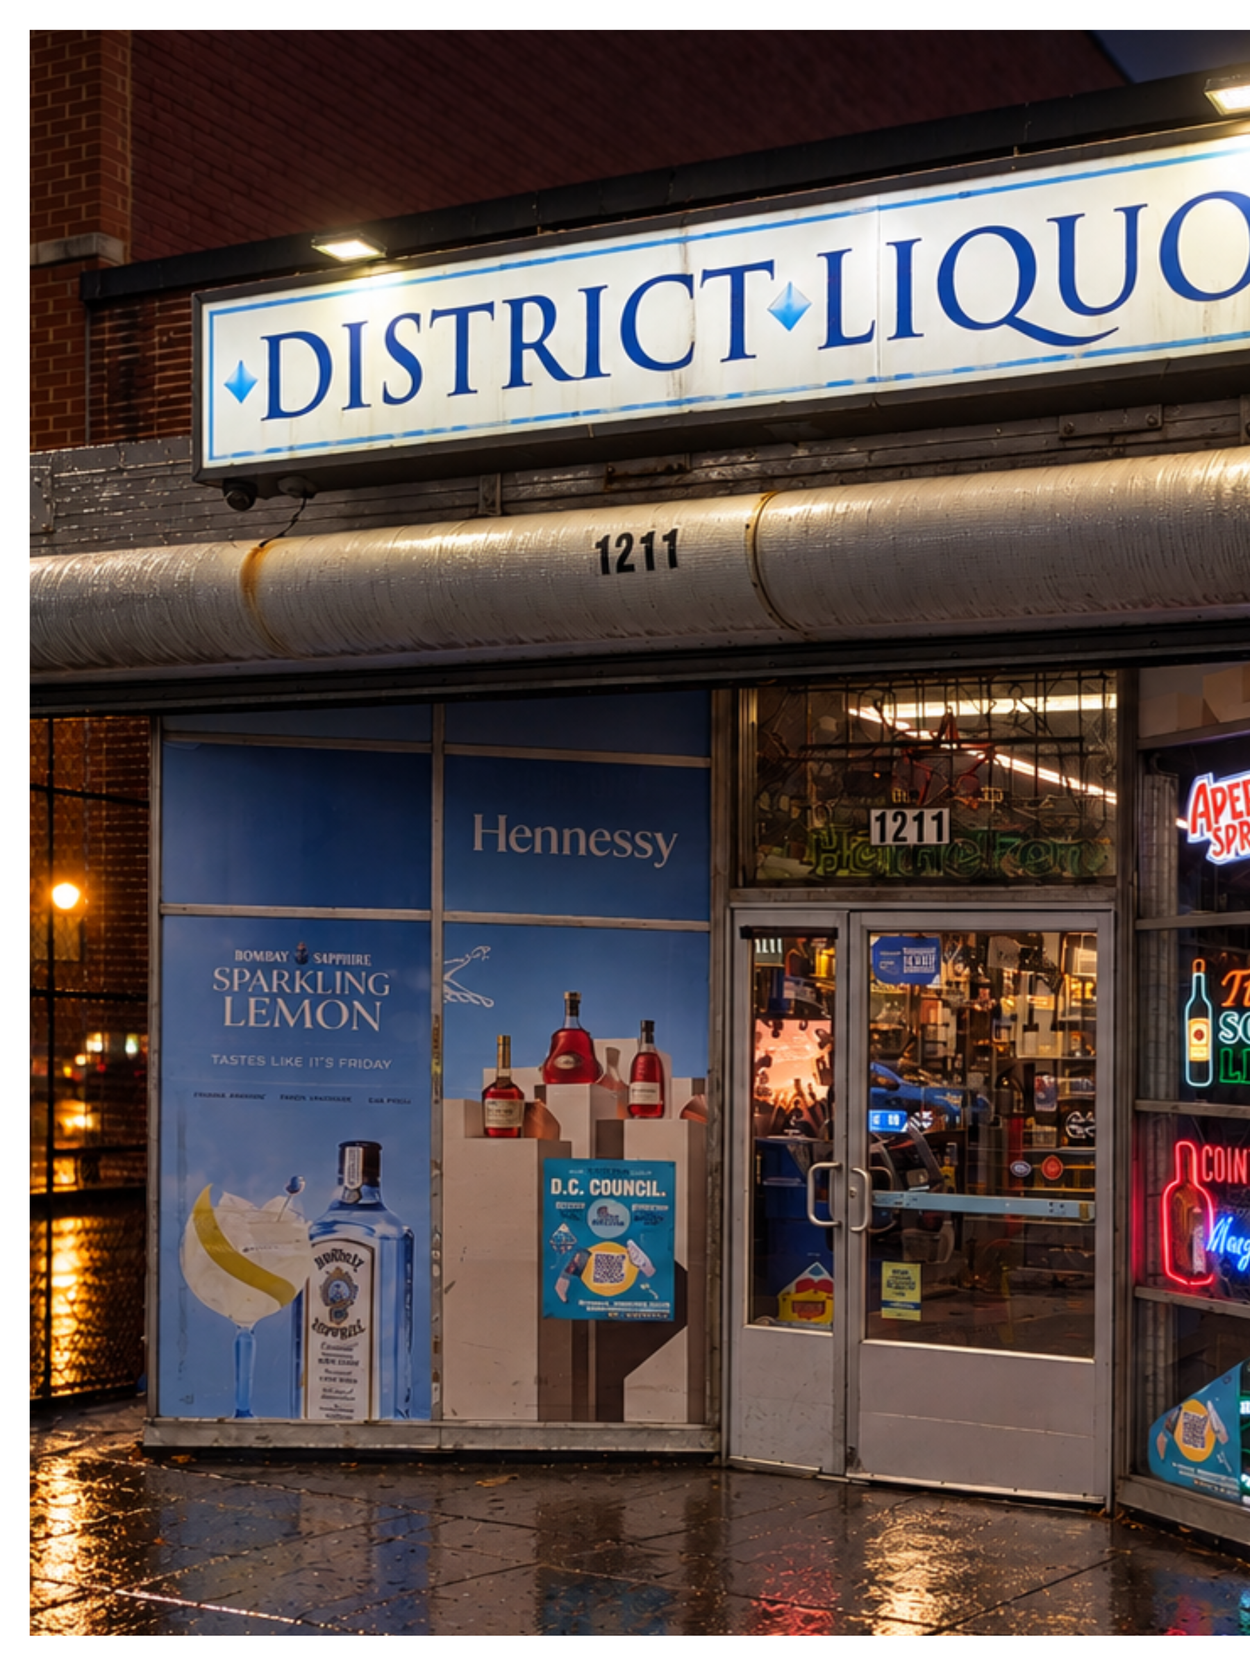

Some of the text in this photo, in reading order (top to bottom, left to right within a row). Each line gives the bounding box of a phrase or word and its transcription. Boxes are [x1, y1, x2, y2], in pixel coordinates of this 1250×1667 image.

[260, 259, 775, 421] DISTRICT
[594, 528, 679, 575] 1211
[473, 813, 679, 868] Hennessy
[875, 810, 944, 843] 1211
[234, 950, 372, 967] BOMBAY SAPPHIRE
[213, 966, 390, 997] SPARKLING
[224, 996, 382, 1032] LEMON
[211, 1054, 266, 1067] TASTES
[271, 1056, 303, 1067] LIKE
[339, 1058, 392, 1070] FRIDAY
[551, 1178, 584, 1196] D.C.
